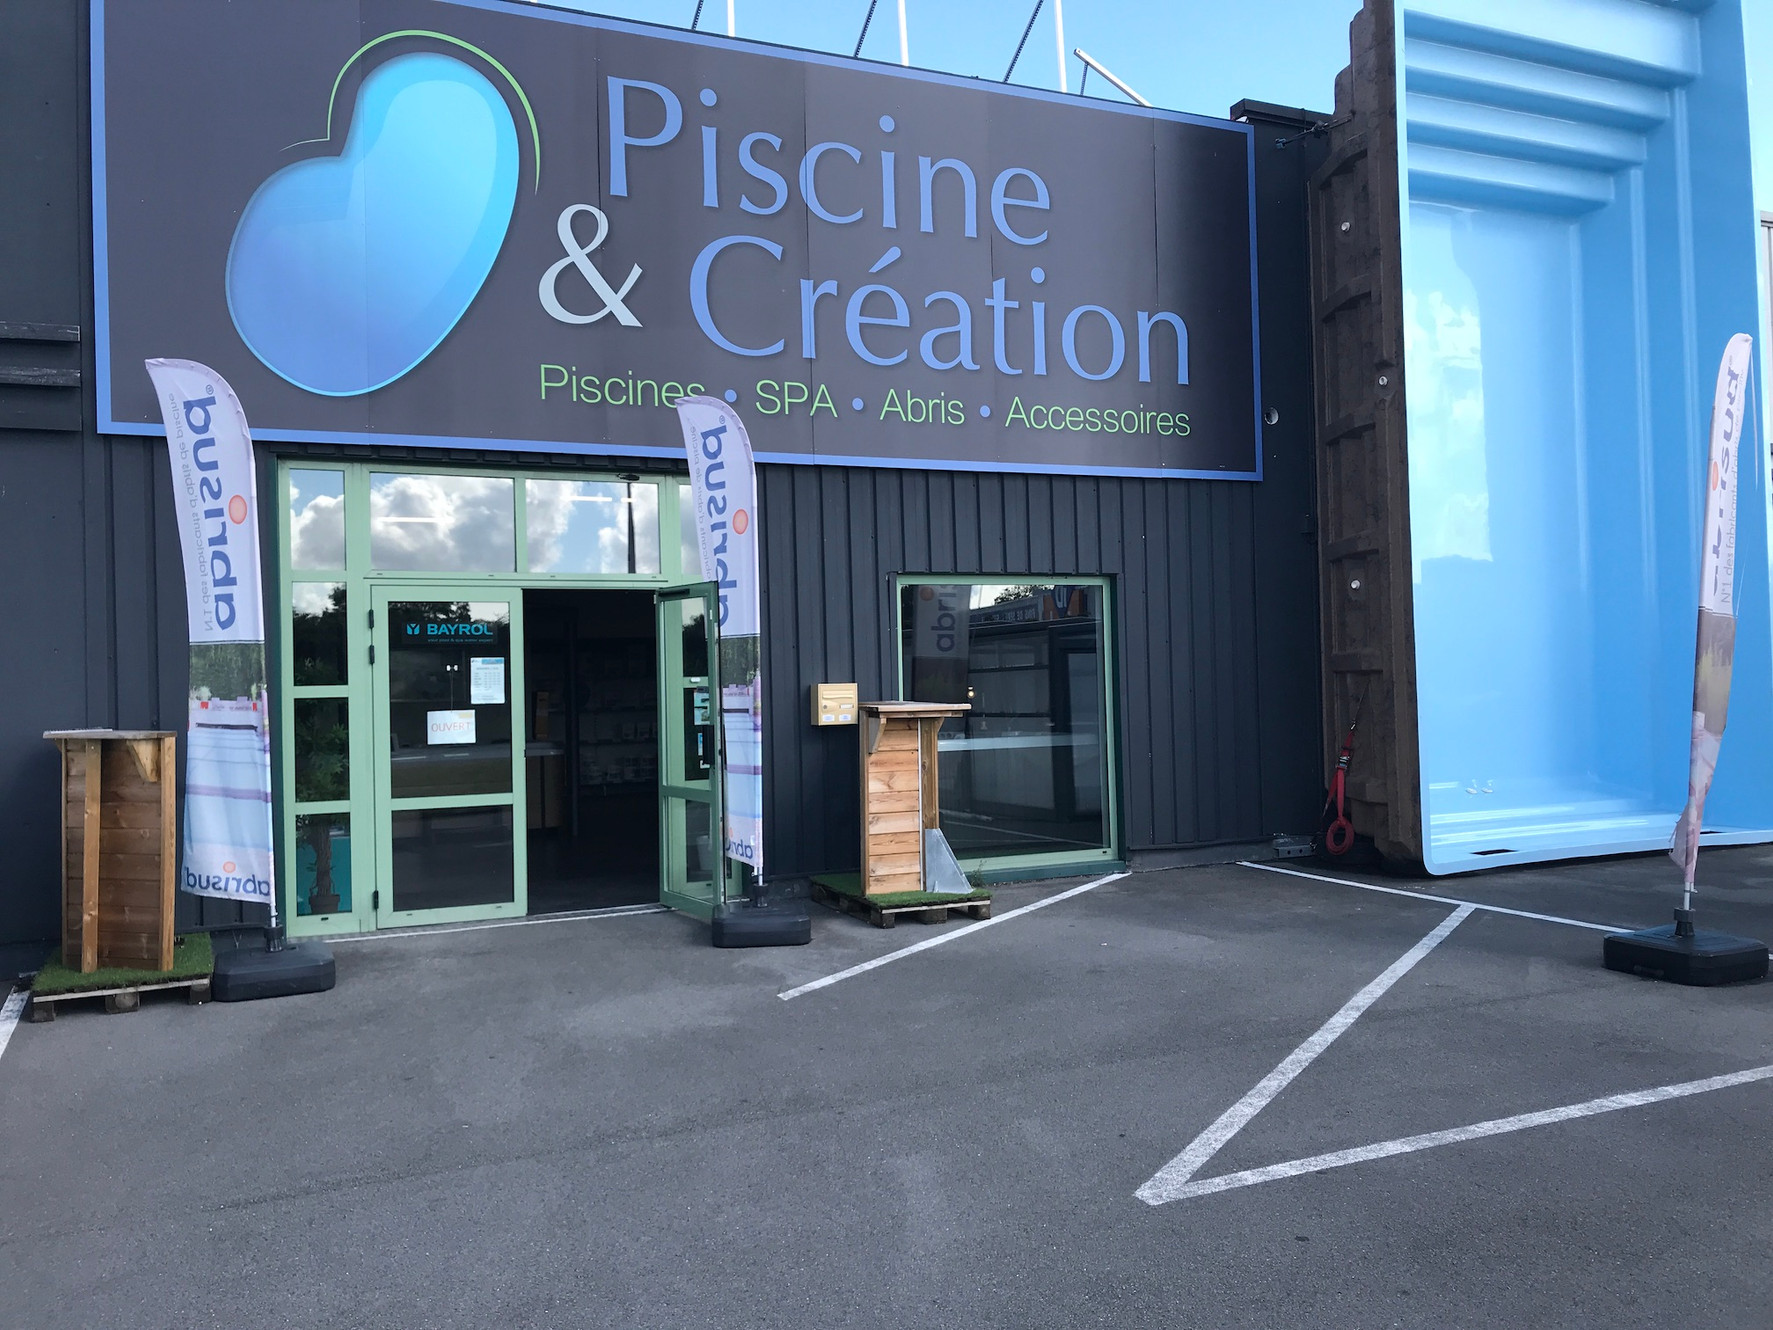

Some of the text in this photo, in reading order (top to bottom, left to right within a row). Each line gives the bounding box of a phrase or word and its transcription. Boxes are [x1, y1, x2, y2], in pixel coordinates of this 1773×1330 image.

[607, 74, 1051, 246] Piscine
[538, 203, 1190, 386] & Création
[540, 364, 1191, 436] Piscines SPA Abris Accessoires
[427, 623, 493, 635] BAYROL
[431, 721, 471, 733] OUVERT
